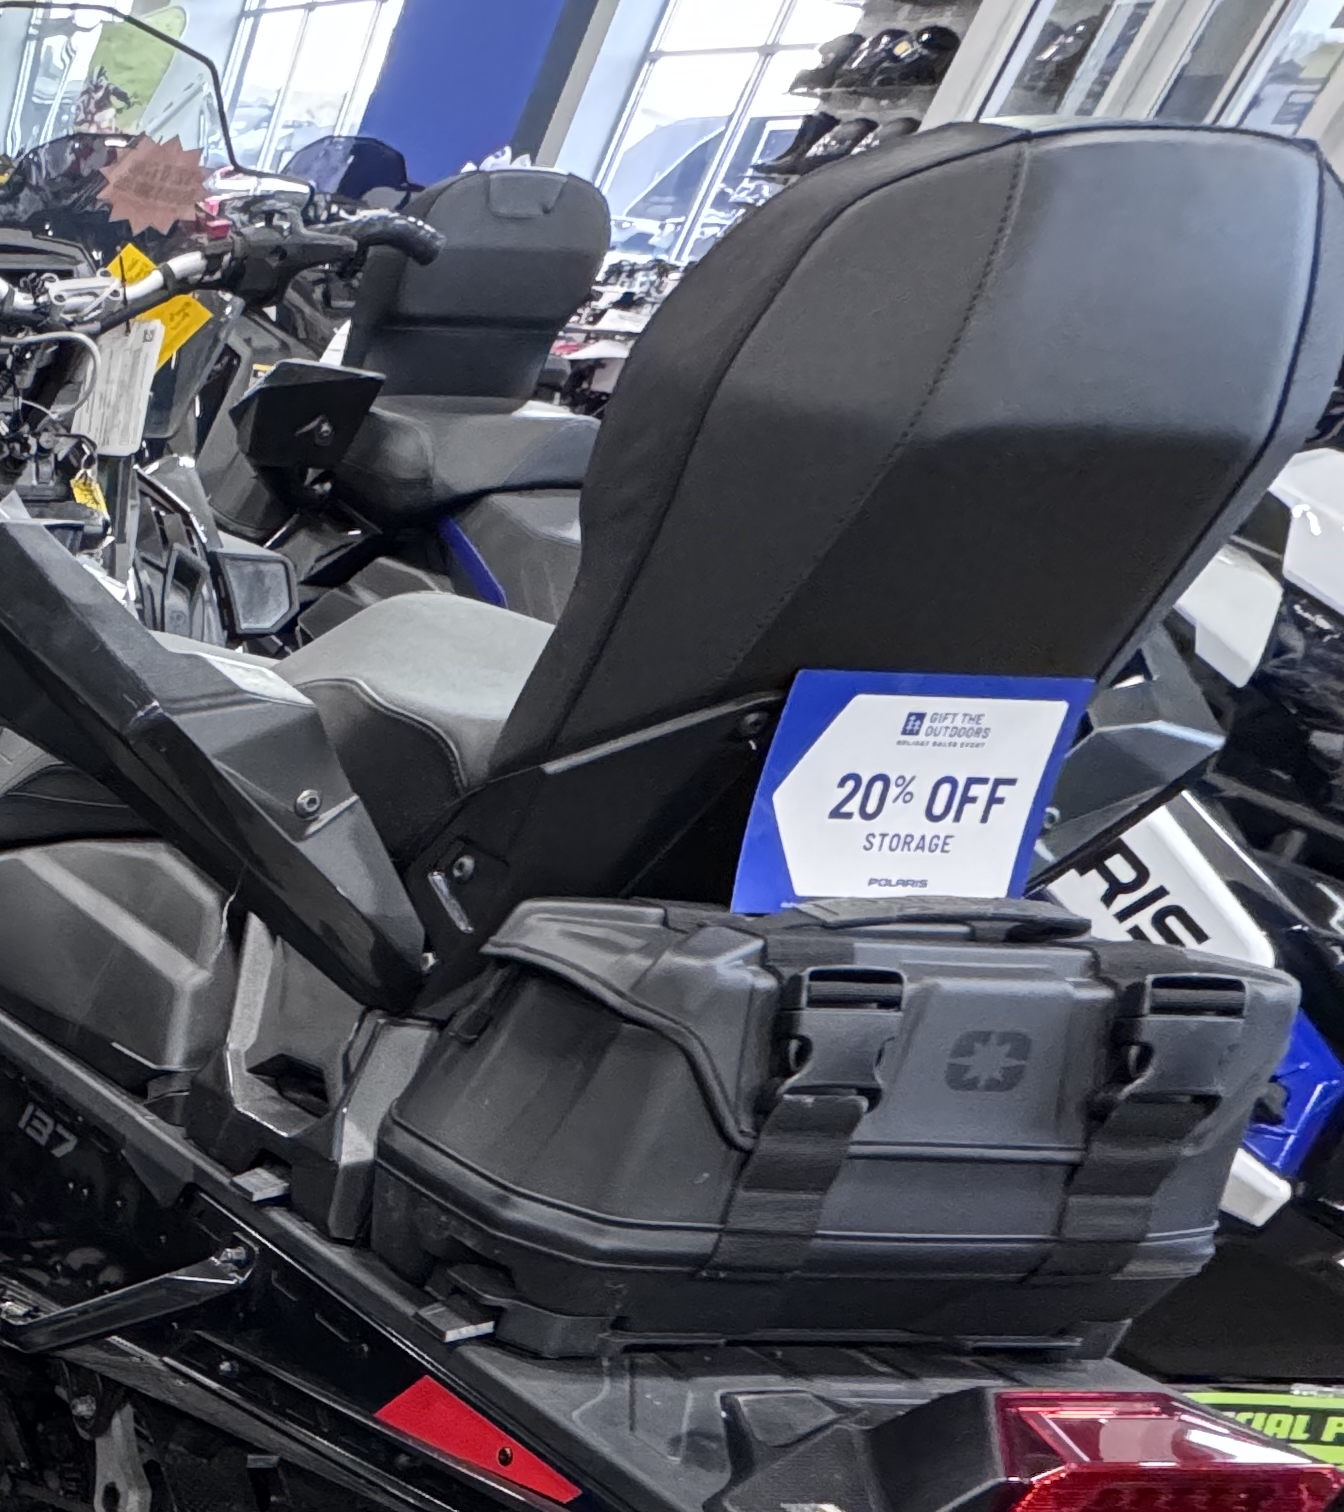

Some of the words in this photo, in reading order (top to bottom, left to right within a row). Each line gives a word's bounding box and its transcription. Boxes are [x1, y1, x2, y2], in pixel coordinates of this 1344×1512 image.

[929, 712, 959, 725] GIFT
[961, 713, 986, 726] THE
[924, 725, 992, 739] OUTDOORS
[827, 772, 917, 822] 20%
[924, 775, 1019, 824] OFF
[862, 832, 956, 854] STORAGE
[867, 877, 929, 889] POLARIS
[17, 1101, 78, 1158] 137
